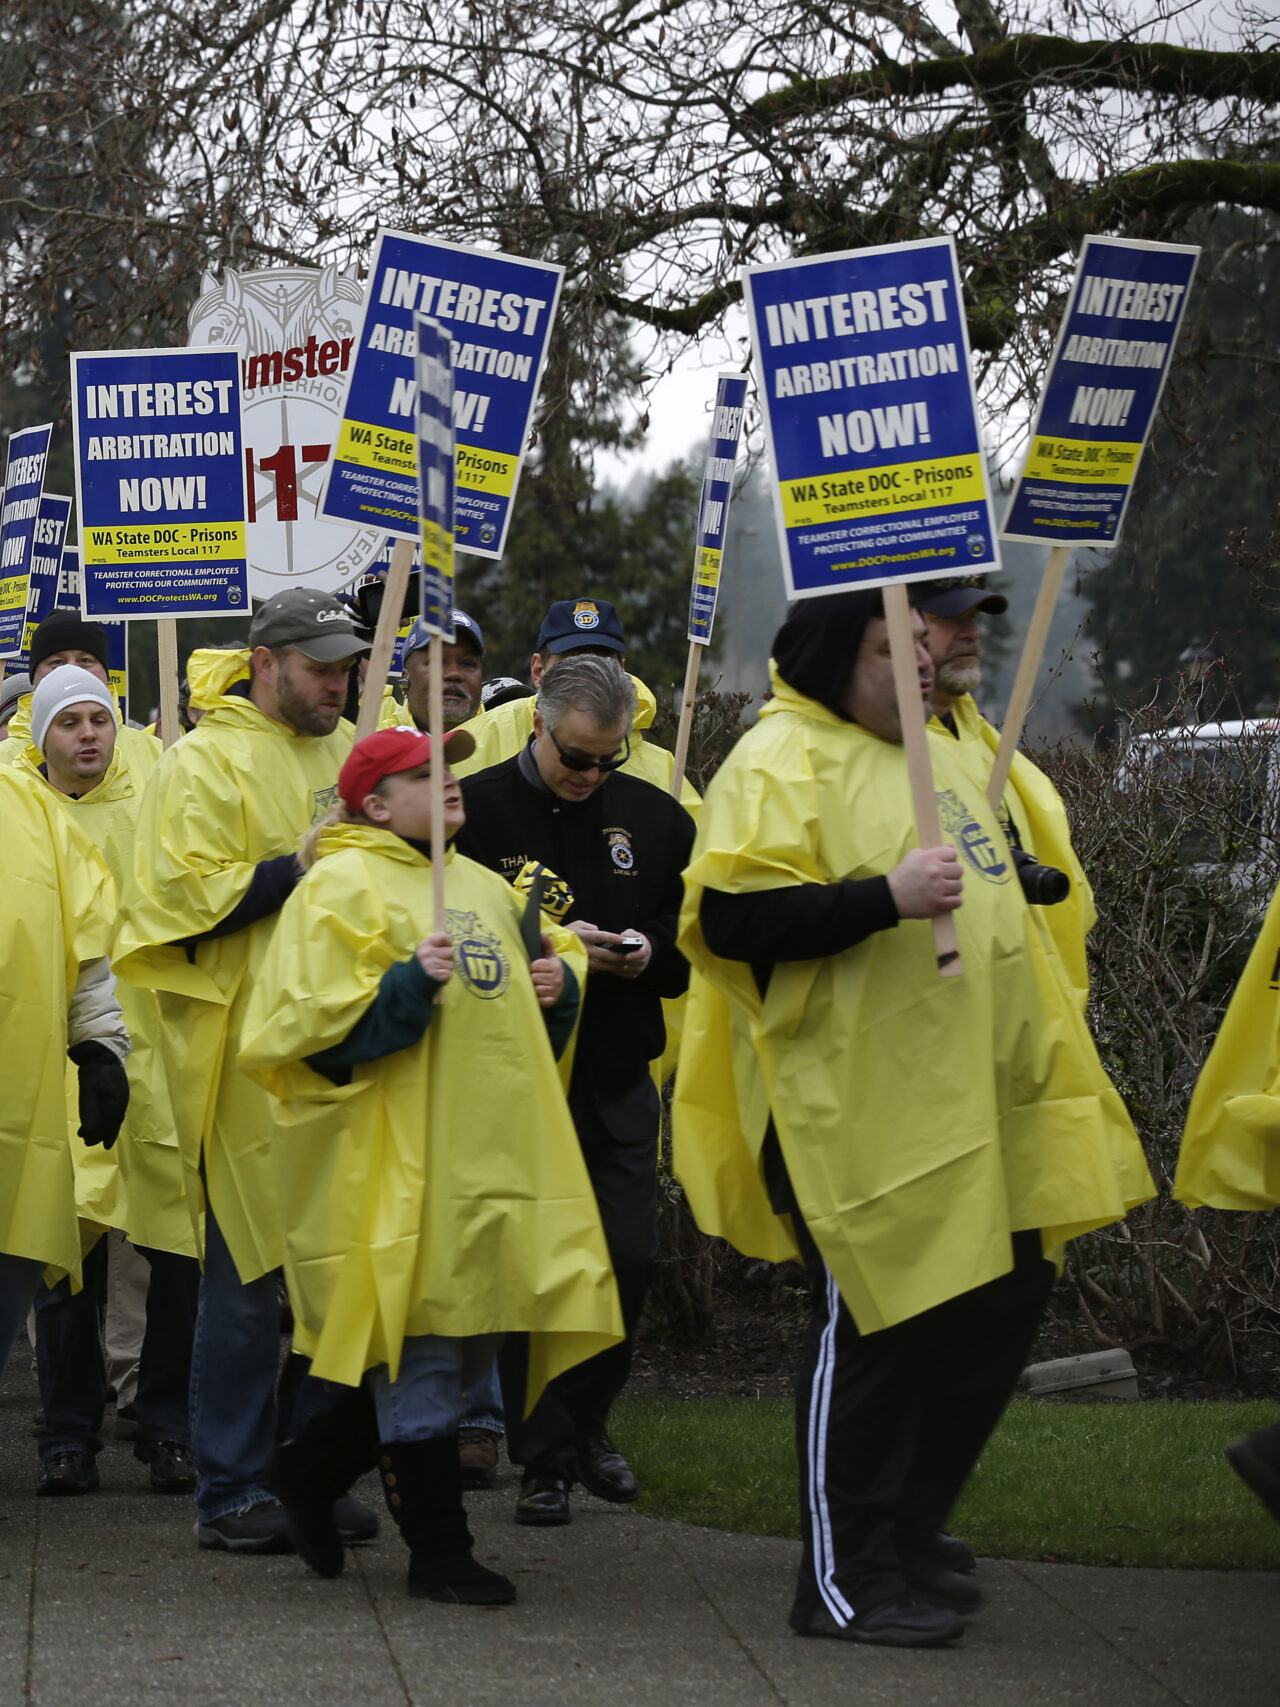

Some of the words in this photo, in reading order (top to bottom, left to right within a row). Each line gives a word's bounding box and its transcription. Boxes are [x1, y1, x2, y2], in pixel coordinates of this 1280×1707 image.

[379, 267, 547, 336] INTEREST
[765, 279, 951, 346] INTEREST
[1077, 275, 1185, 322] INTEREST
[242, 336, 355, 390] mster
[368, 322, 532, 381] ARBRATION
[1062, 334, 1169, 369] ARBITRATION
[775, 343, 959, 398] ARBITRATION
[86, 380, 233, 419] INTEREST
[388, 375, 491, 432] NW!
[1069, 386, 1136, 427] NOW!
[88, 432, 235, 461] ARBITRATION
[818, 401, 932, 458] NOW!
[350, 427, 372, 445] WA
[376, 433, 413, 454] State
[456, 451, 508, 475] Prisons
[373, 452, 418, 470] Teamste
[465, 473, 486, 485] 117
[119, 476, 207, 513] NOW!
[341, 470, 385, 487] TEAMSTER
[385, 480, 420, 494] CORREC
[350, 485, 403, 503] PROTECTING
[791, 483, 819, 503] WA
[821, 476, 865, 499] State
[867, 470, 902, 492] DOC
[913, 460, 974, 485] Prisons
[823, 495, 890, 515] Teamsters
[892, 489, 927, 506] Local
[929, 486, 953, 500] 117
[92, 532, 113, 546] WA
[116, 530, 150, 545] State
[153, 528, 180, 543] DOC
[191, 526, 238, 542] Prisons
[798, 528, 848, 545] TEAMSTER
[849, 518, 922, 537] CORRECTIONAL
[924, 510, 979, 527] EMPLOYEES
[815, 538, 874, 555] PROTECTING
[875, 534, 898, 547] OUR
[899, 525, 967, 544] COMMUNITIES
[116, 547, 169, 558] Teamsters
[171, 545, 199, 556] Local
[201, 545, 220, 555] 117
[93, 570, 134, 579] TEAMSTER
[134, 568, 193, 578] CORRECTIONAL
[194, 567, 239, 576] EMPLOYEES
[105, 580, 154, 589] PROTECTING
[154, 579, 173, 588] OUR
[173, 577, 228, 587] COMMUNITIES
[117, 592, 218, 603] www.DOCProtectsWA.org
[580, 616, 593, 624] 117
